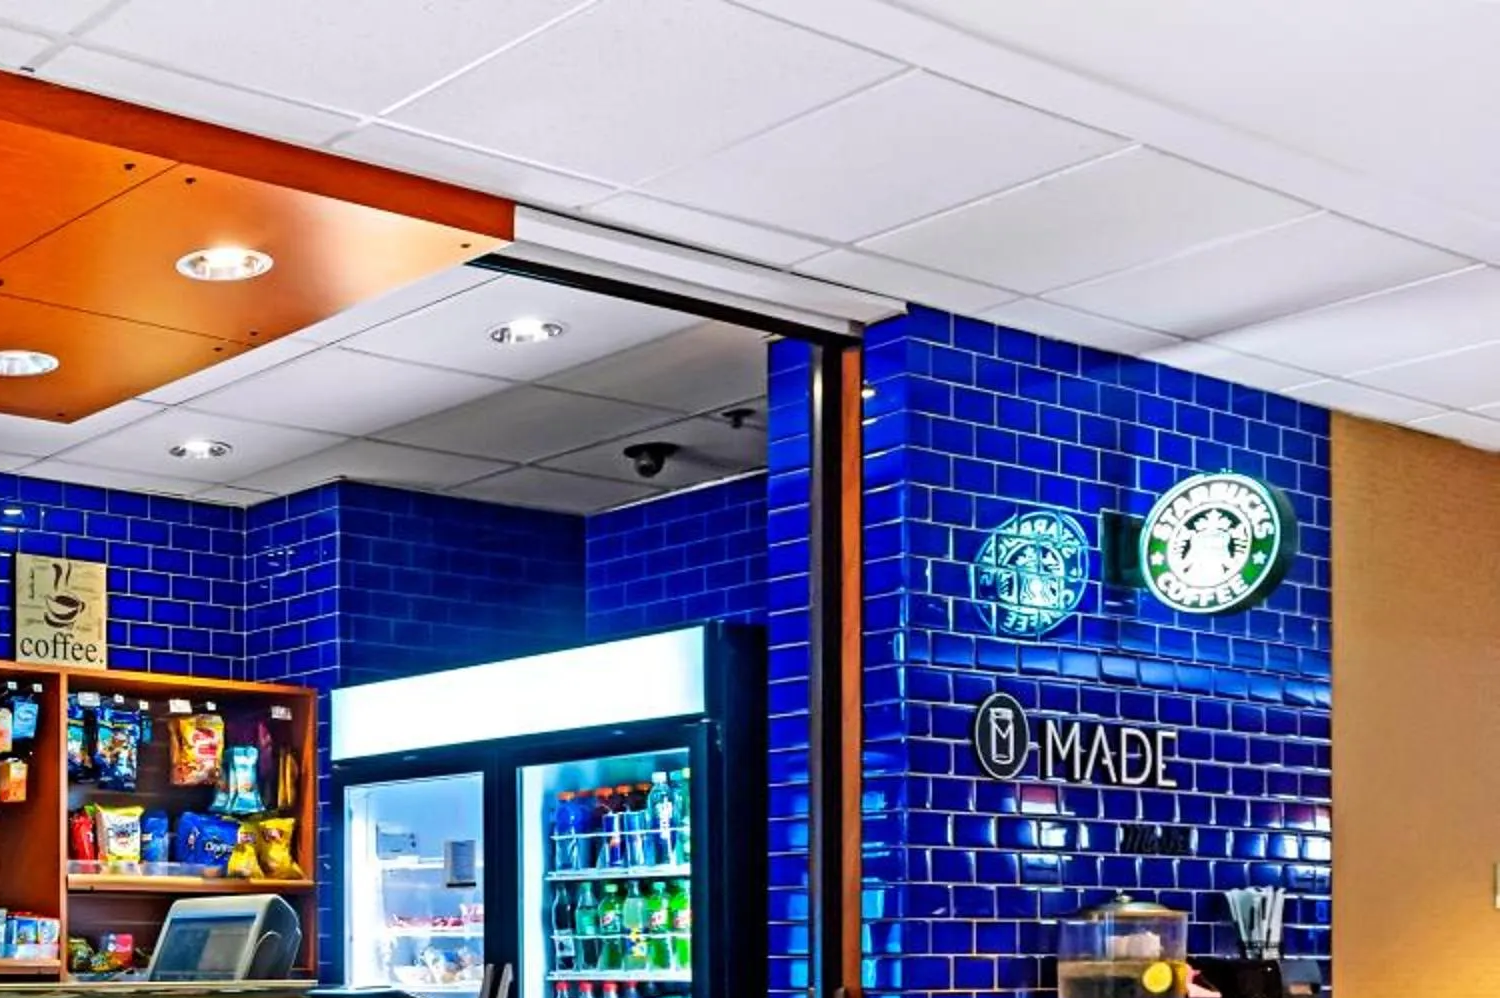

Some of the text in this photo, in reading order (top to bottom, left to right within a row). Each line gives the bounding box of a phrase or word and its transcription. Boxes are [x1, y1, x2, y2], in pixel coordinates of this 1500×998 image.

[1152, 481, 1275, 541] STARBUCKS
[1156, 571, 1249, 607] COFFEE
[19, 631, 104, 665] coffee.
[1045, 719, 1178, 787] MADE
